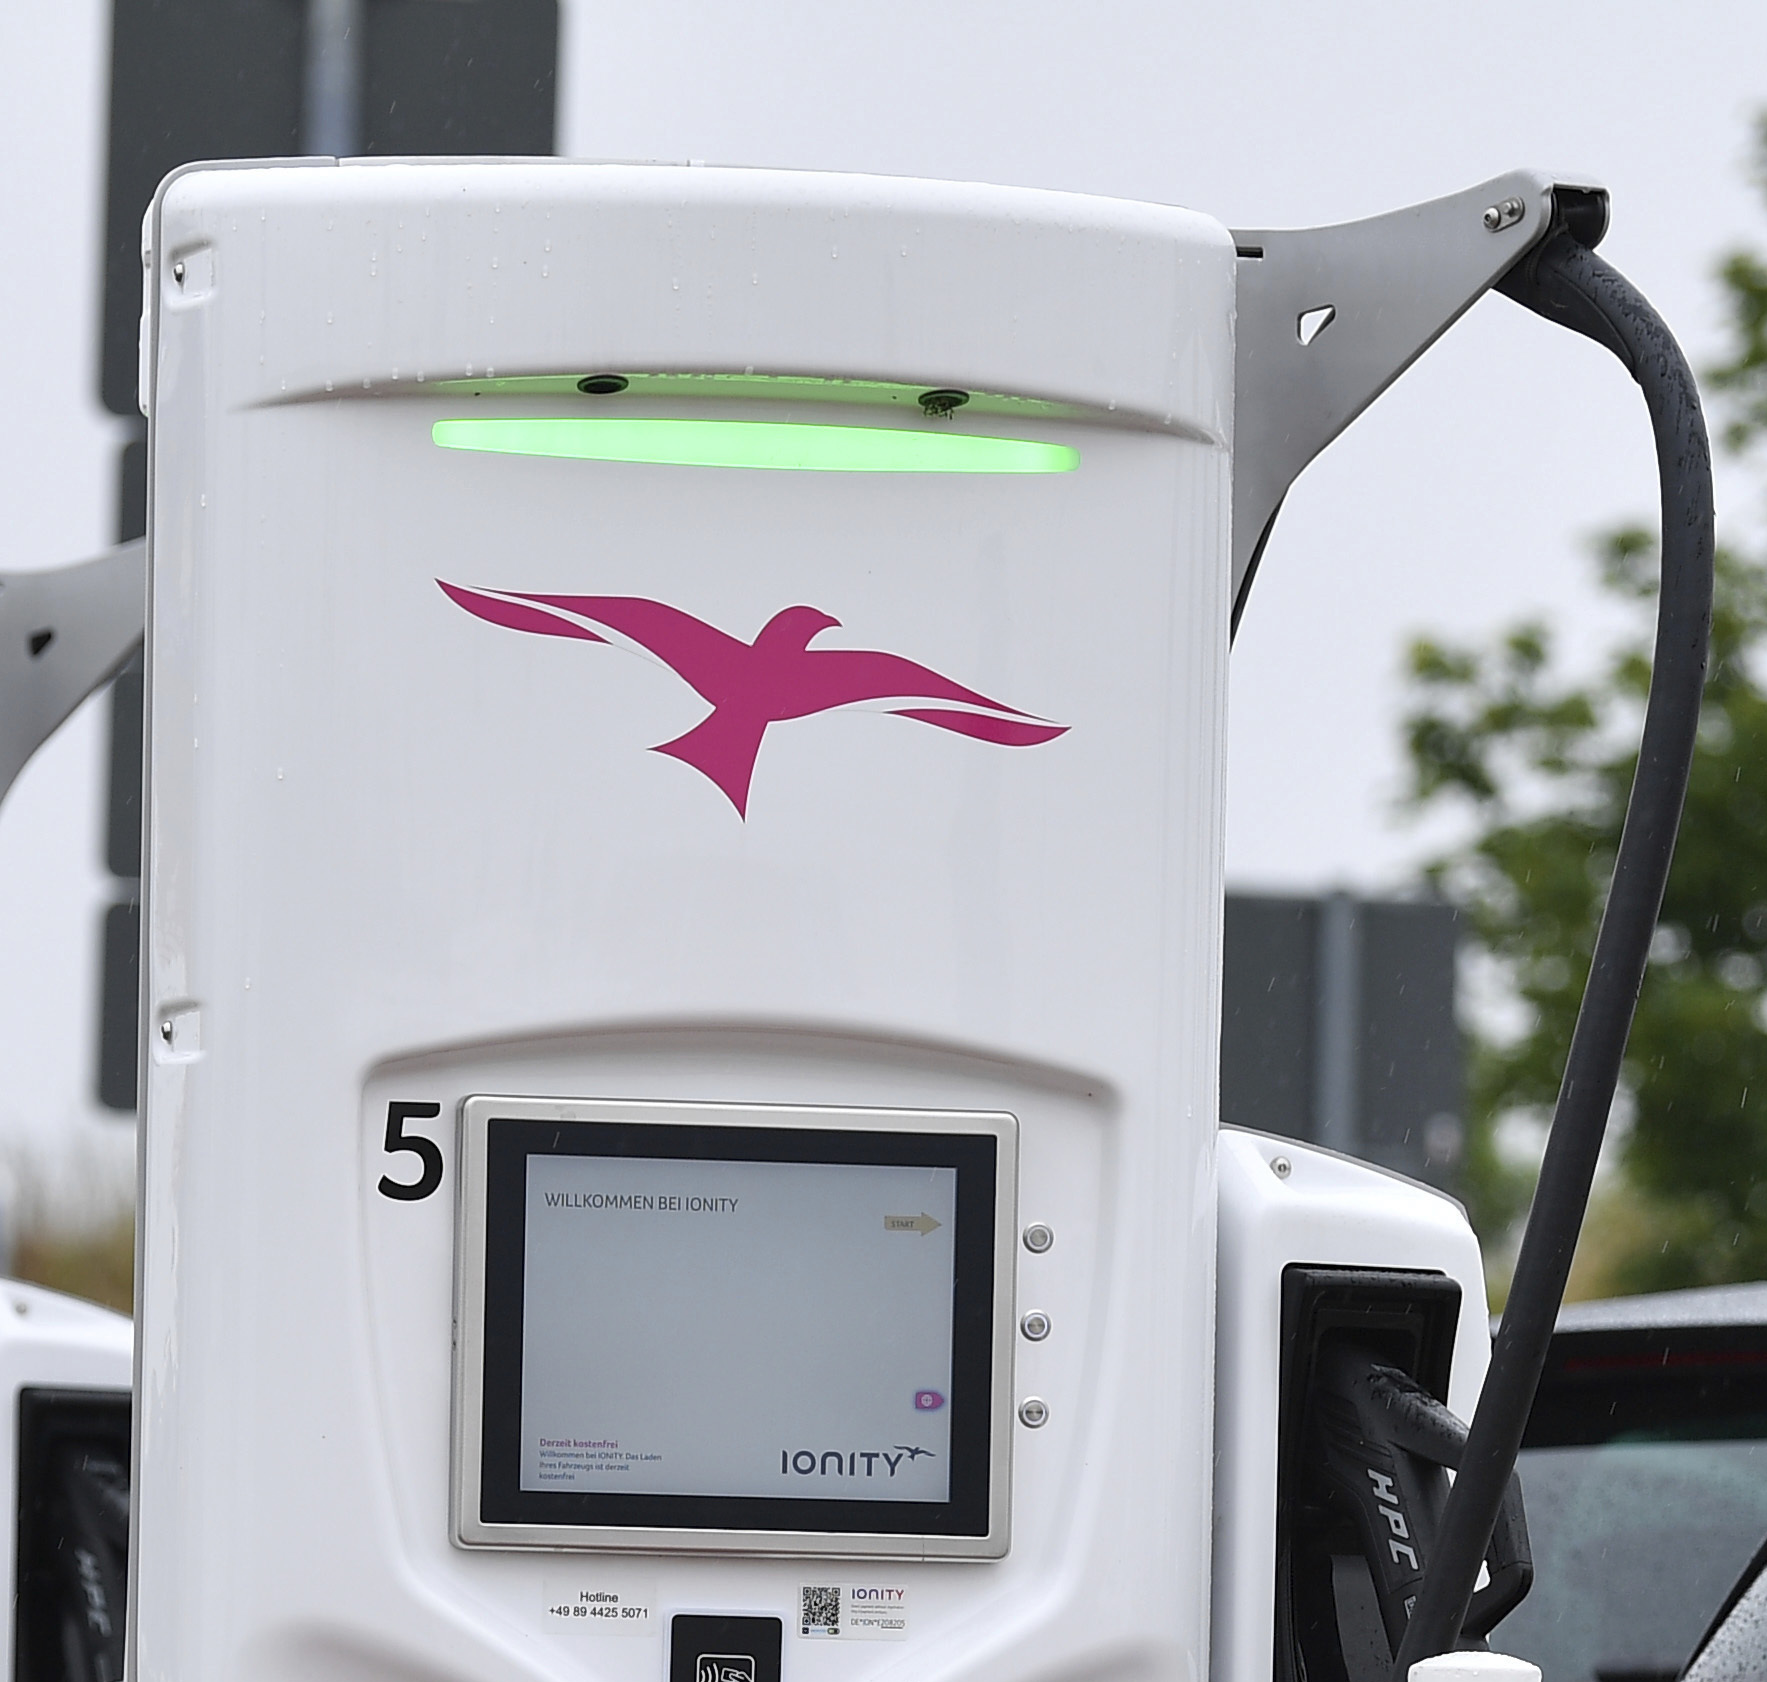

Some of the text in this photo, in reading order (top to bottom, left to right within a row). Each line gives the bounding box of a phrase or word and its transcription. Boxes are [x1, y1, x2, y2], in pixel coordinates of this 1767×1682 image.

[378, 1101, 444, 1201] 5
[544, 1192, 739, 1213] WILLKOMMEN BEI IONITY
[539, 1438, 619, 1449] Derzeit kostenfrei
[539, 1450, 585, 1460] Willkommen
[640, 1454, 662, 1462] Laden
[781, 1450, 904, 1477] IONITY
[538, 1472, 575, 1481] kostenfrei
[1367, 1468, 1419, 1570] HPC
[579, 1591, 619, 1603] Hotline
[851, 1587, 905, 1601] IONITY
[549, 1605, 648, 1619] +49 89 4425 5071
